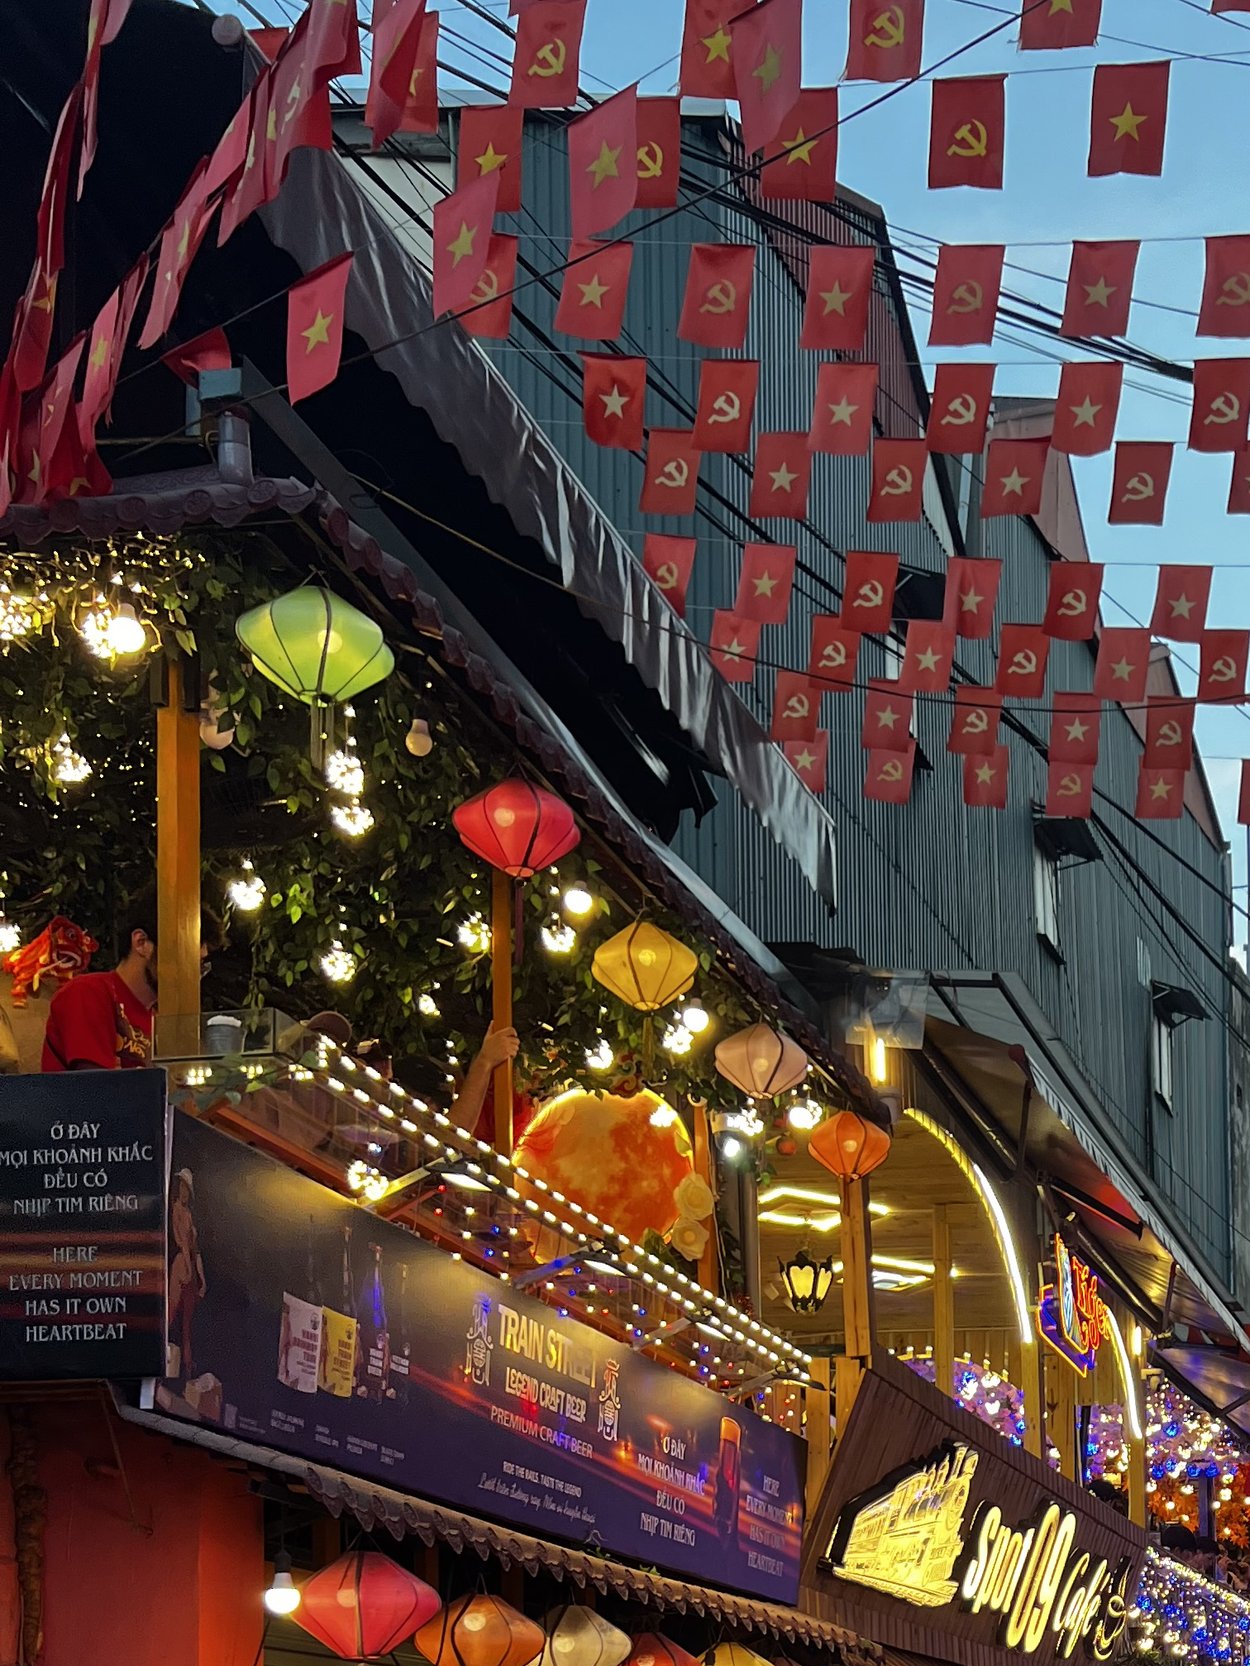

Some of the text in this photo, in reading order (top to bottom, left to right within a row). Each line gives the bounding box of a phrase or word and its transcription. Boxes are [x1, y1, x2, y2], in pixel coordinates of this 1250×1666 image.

[68, 1121, 100, 1139] ĐÂY
[33, 1143, 102, 1165] KHOẢNH
[83, 1168, 108, 1187] CÓ
[13, 1192, 138, 1217] NHỊP TIM RIÊNG
[53, 1246, 99, 1263] HERE
[9, 1270, 144, 1291] EVERY MOMENT
[25, 1297, 127, 1316] HAS IT OWN
[26, 1323, 127, 1343] HEARTBEAT
[498, 1303, 596, 1388] TRAIN STREET
[505, 1366, 587, 1423] LEGEND CRAFT BEER
[490, 1406, 593, 1459] PREMIUM CRAFT BEER
